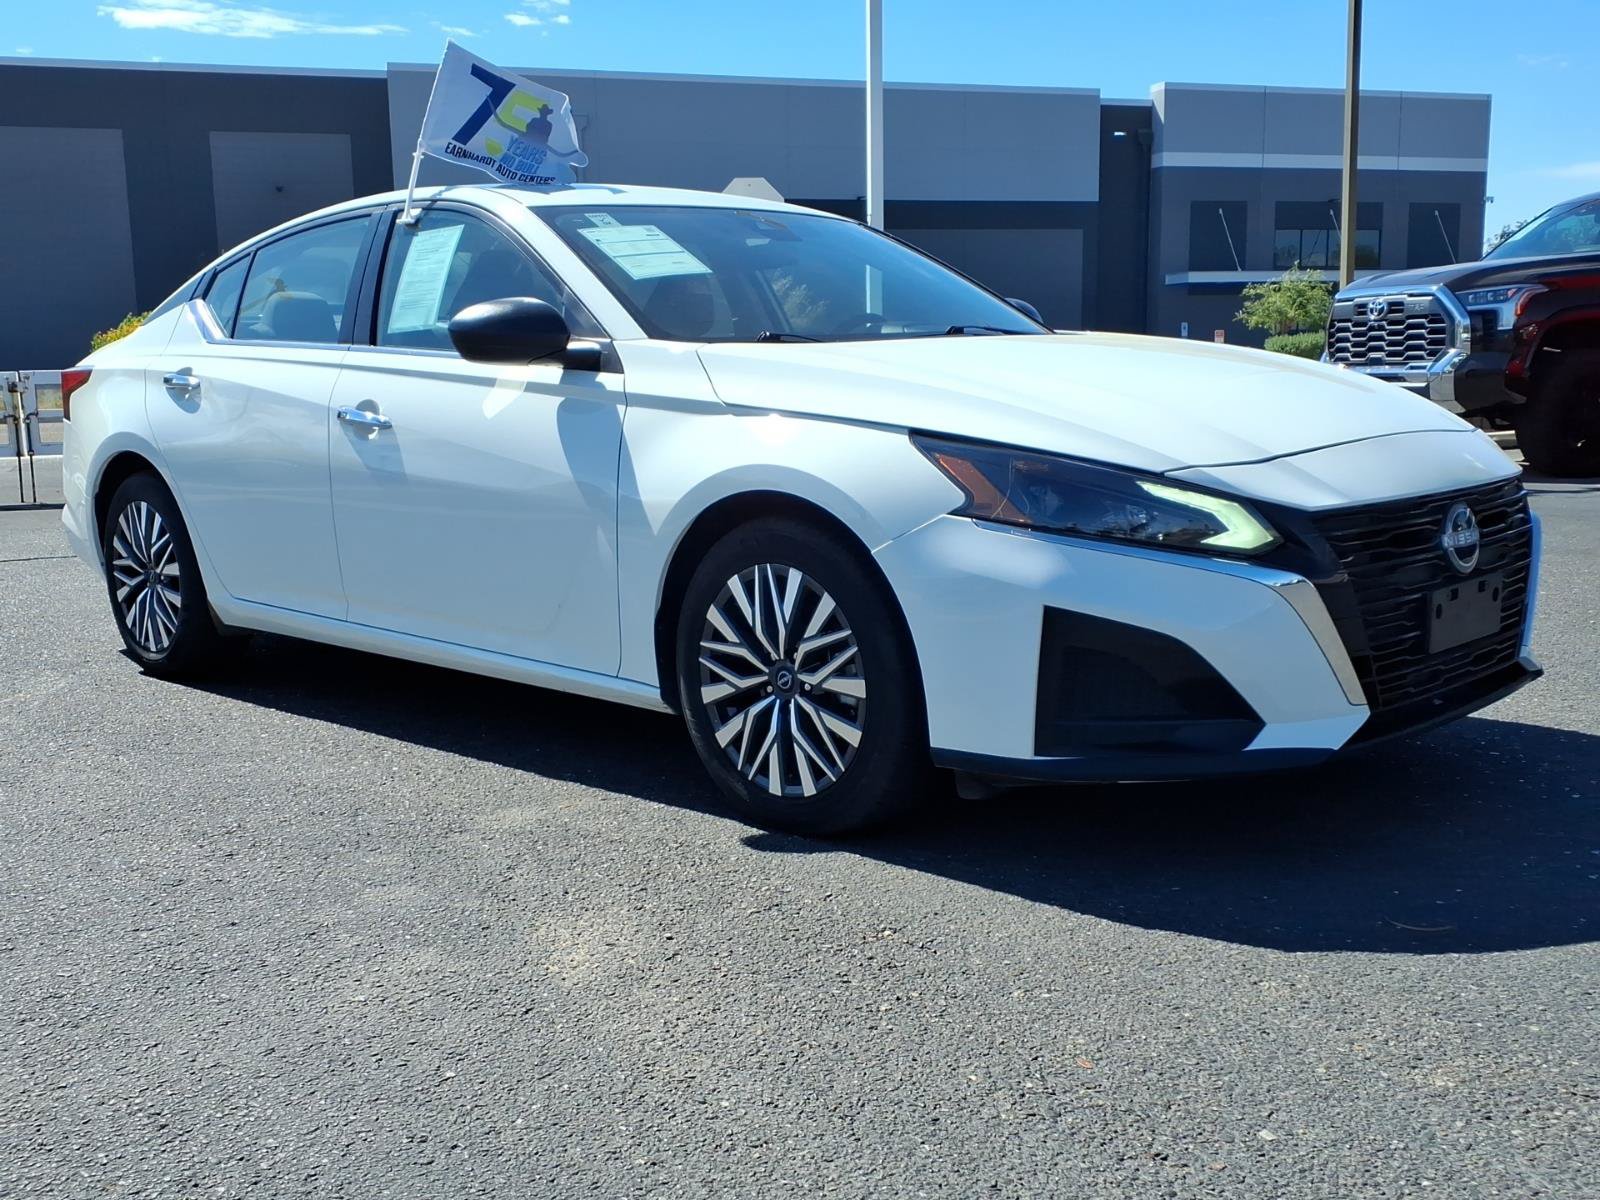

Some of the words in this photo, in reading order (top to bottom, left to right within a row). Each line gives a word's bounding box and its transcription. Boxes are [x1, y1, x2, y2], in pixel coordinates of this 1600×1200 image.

[444, 142, 497, 168] EARNHARDT
[495, 163, 518, 180] AUTO
[518, 173, 556, 184] CENTERS
